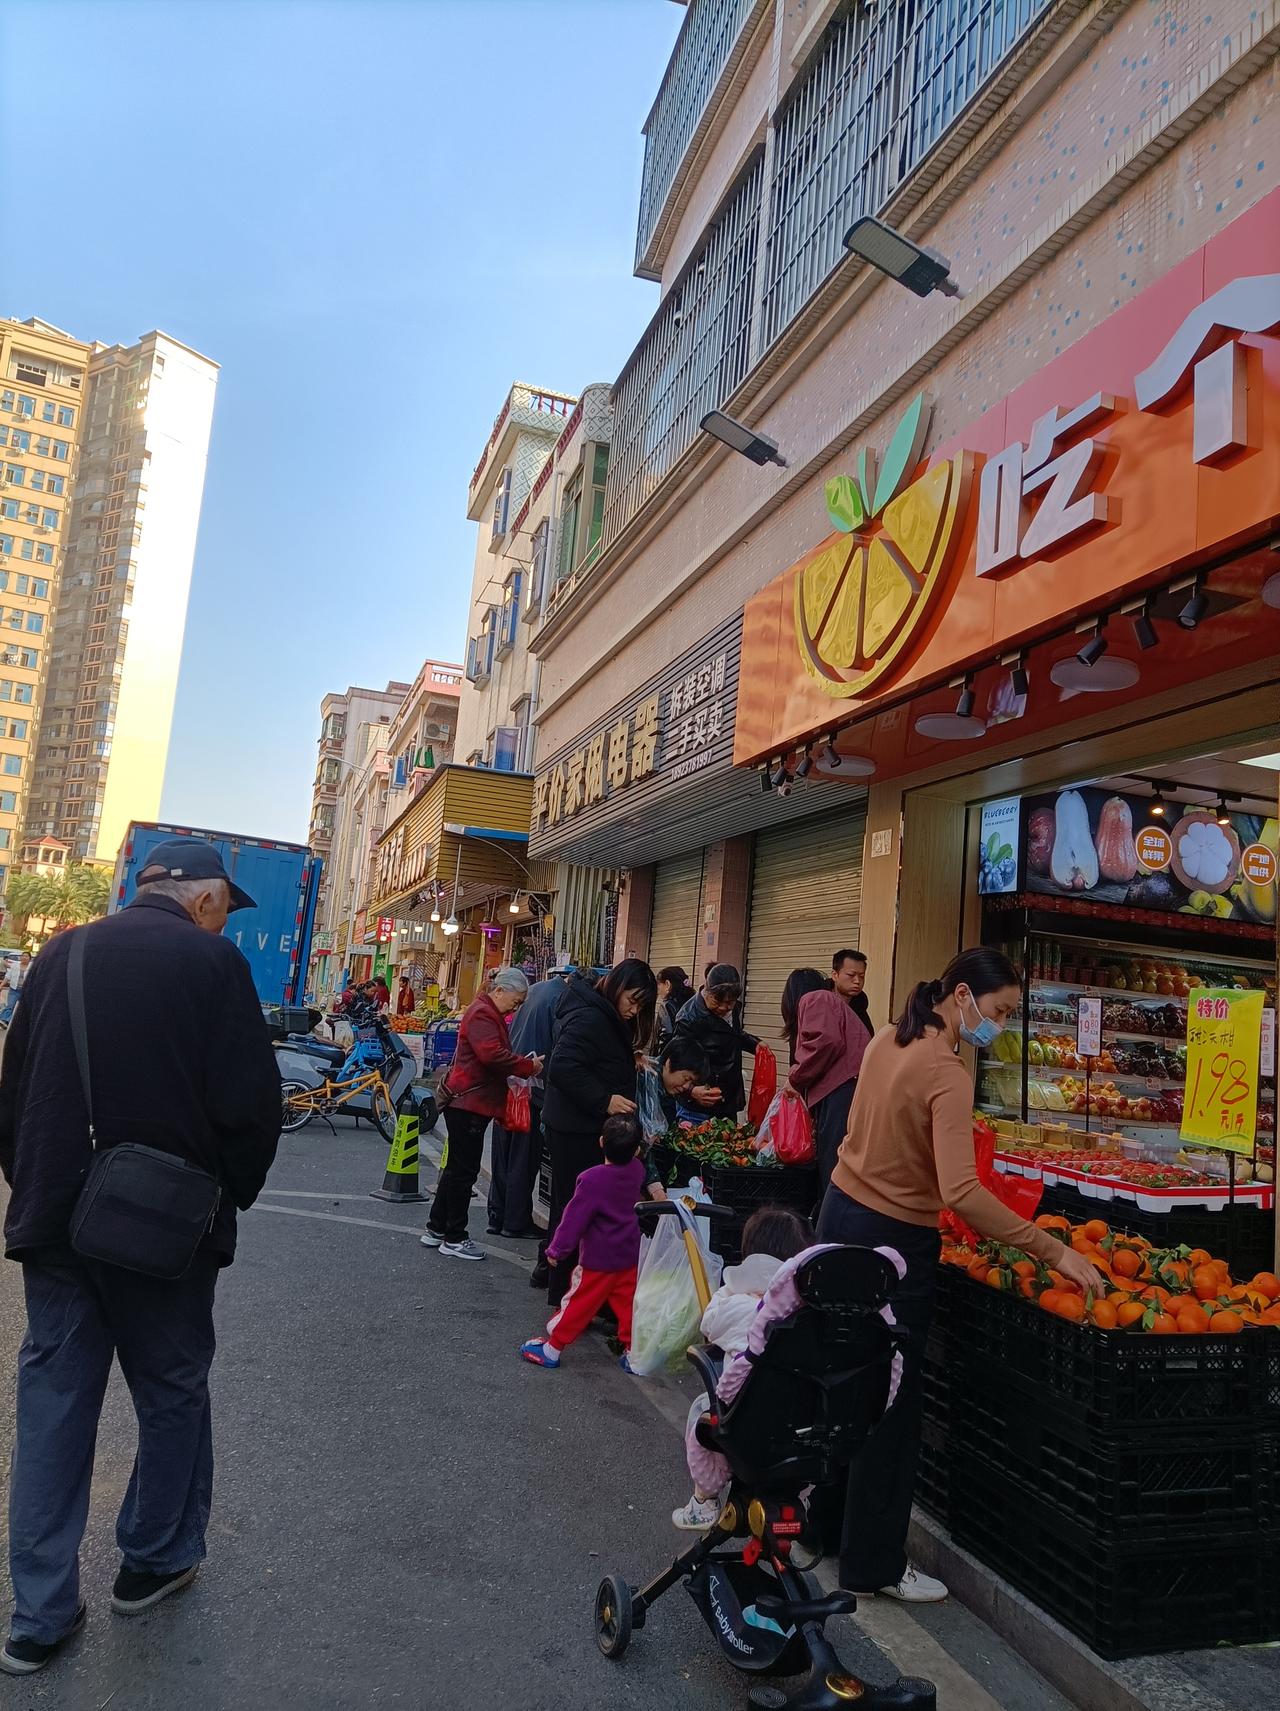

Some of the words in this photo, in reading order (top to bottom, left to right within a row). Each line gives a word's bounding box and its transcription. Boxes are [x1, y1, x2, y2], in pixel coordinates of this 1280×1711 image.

[670, 652, 728, 721] 拆装空调
[666, 700, 724, 760] 二手买卖
[984, 805, 1018, 819] BLUEBERRY
[1197, 998, 1230, 1020] 特价
[1190, 1053, 1250, 1119] 1.98
